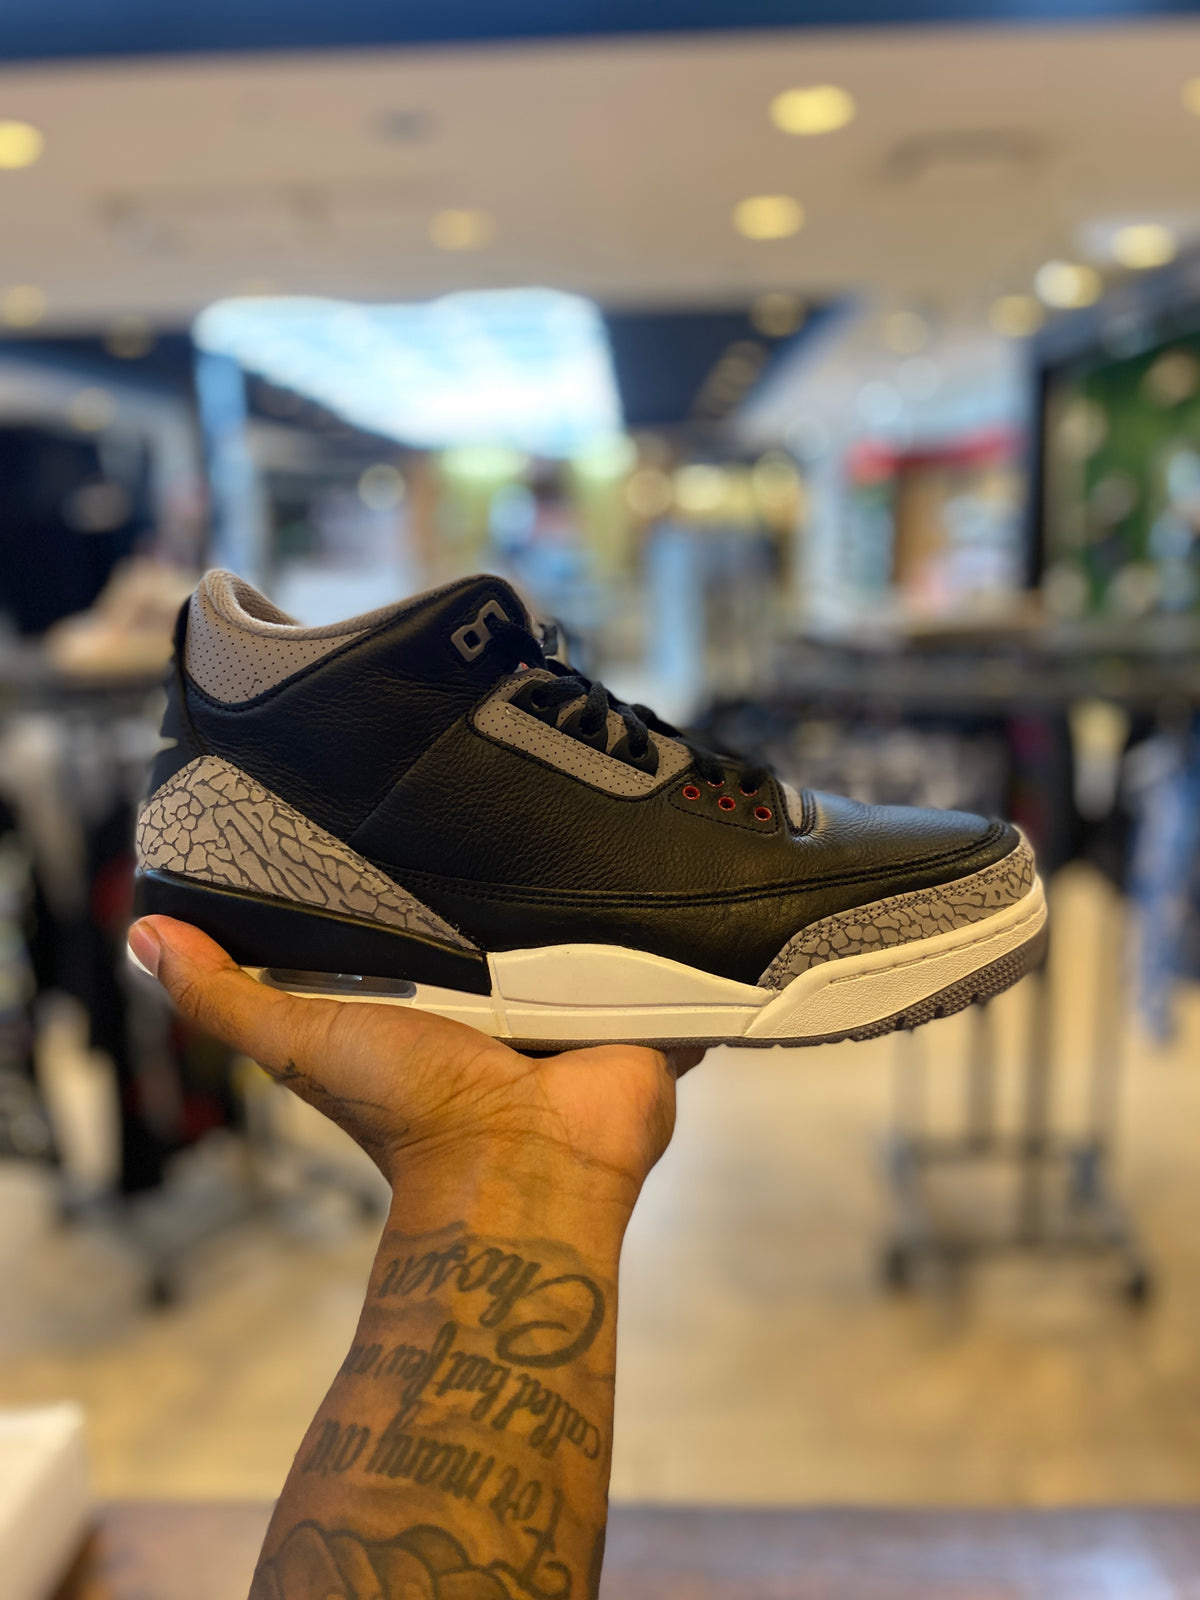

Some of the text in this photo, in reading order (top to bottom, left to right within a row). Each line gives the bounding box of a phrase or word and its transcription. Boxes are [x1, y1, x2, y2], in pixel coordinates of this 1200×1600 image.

[379, 1244, 606, 1369] Chosen
[432, 1352, 513, 1422] but
[493, 1373, 602, 1461] called
[366, 1408, 496, 1500] many
[489, 1466, 573, 1599] For
